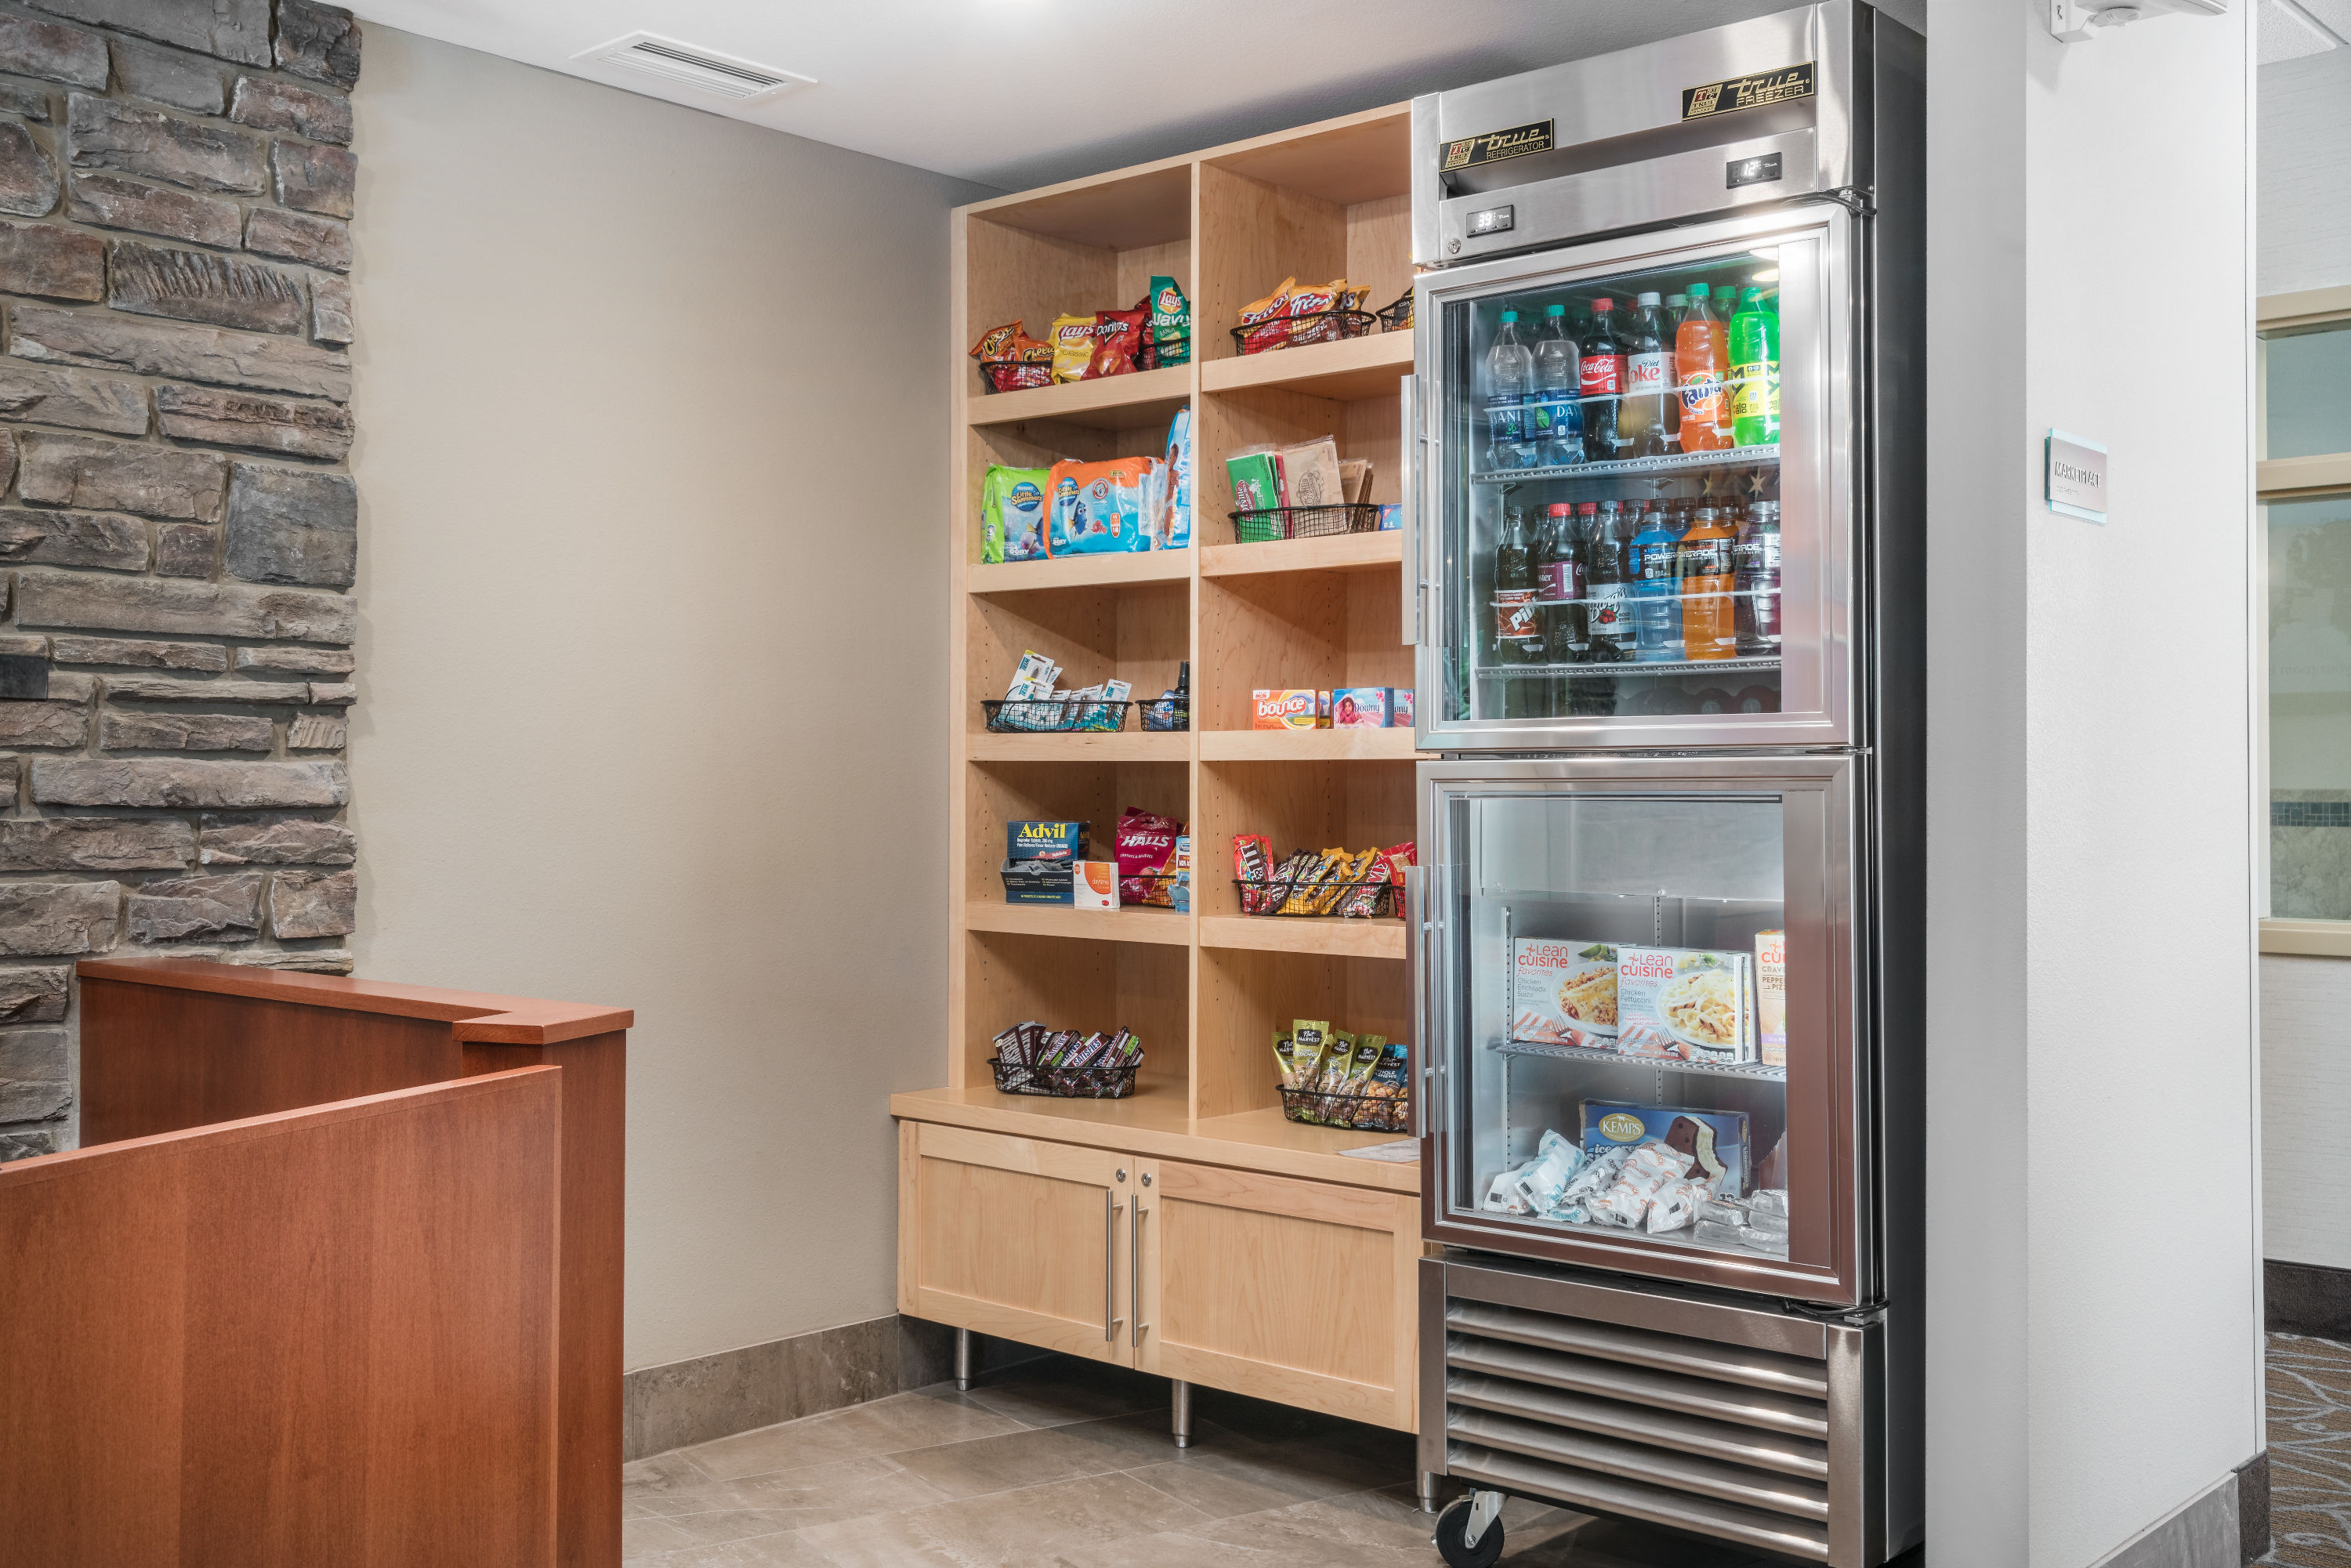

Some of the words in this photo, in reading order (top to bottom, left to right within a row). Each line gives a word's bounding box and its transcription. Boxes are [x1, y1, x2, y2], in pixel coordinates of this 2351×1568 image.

[1737, 85, 1804, 107] FREEZER
[1486, 141, 1545, 160] REFRIGERATOR
[1478, 212, 1492, 227] 39
[1160, 291, 1182, 309] Lay's
[1058, 324, 1096, 341] Lay's
[1062, 349, 1089, 358] Classic
[1641, 360, 1660, 368] Diet
[2055, 461, 2101, 488] MARKETPLACE
[1011, 495, 1043, 505] Swimmers
[1016, 491, 1033, 499] Little
[1020, 657, 1031, 672] TRIM
[1019, 683, 1030, 697] TRIM
[1105, 686, 1114, 698] TRIM
[1258, 697, 1306, 719] bounce
[1354, 702, 1380, 714] Downy
[1017, 823, 1067, 838] Advil
[1121, 835, 1171, 847] HALLS
[1092, 878, 1109, 886] daytime
[1536, 944, 1568, 958] Lean
[1639, 954, 1673, 967] Lean
[1516, 966, 1553, 977] favorites
[1618, 976, 1657, 987] favorites
[1621, 988, 1646, 997] Chicken
[1620, 995, 1651, 1004] Fettuccini
[1303, 1030, 1316, 1039] Nut
[1072, 1037, 1102, 1066] SATISFIES
[1603, 1121, 1641, 1135] KEMPS
[1595, 1144, 1612, 1154] ice
